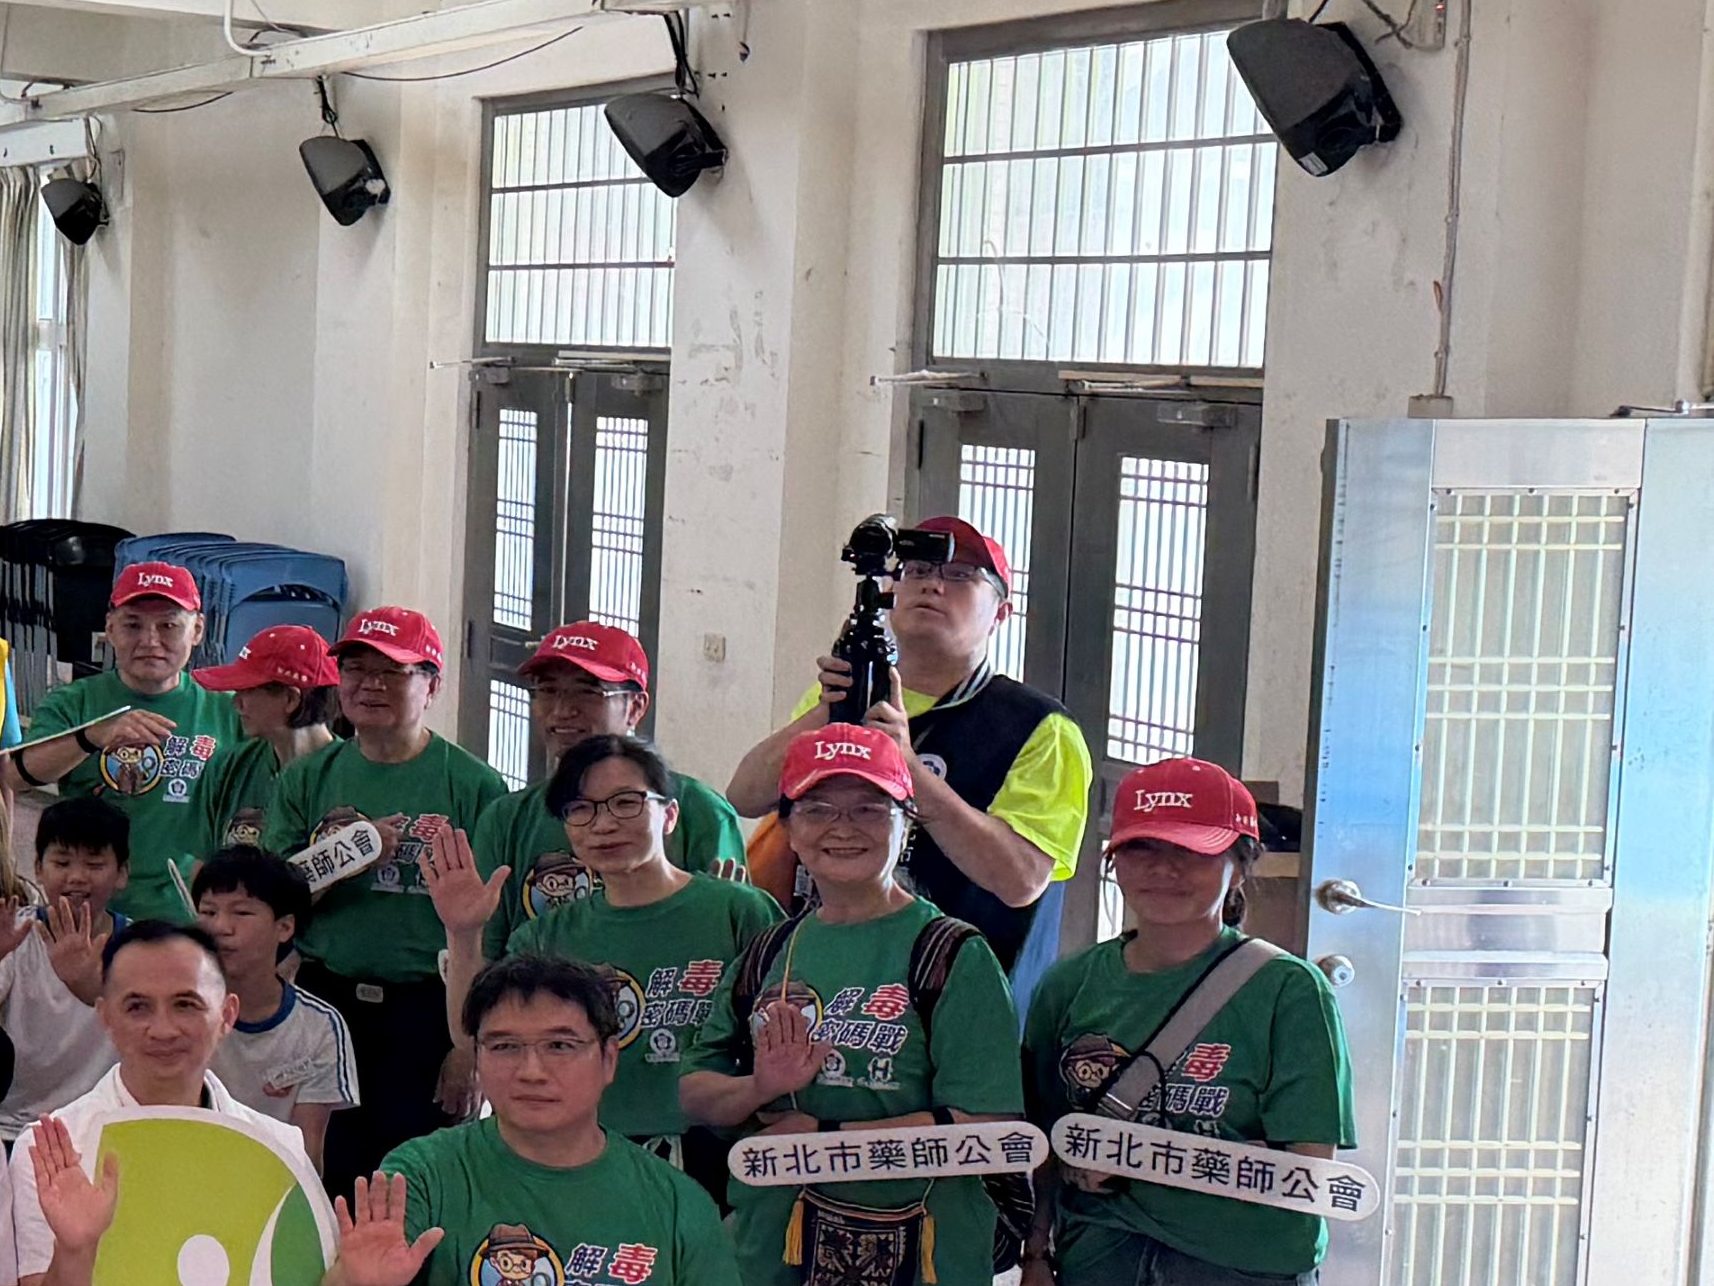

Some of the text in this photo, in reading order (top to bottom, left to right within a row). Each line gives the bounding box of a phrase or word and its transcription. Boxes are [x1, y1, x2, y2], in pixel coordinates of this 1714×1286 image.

[138, 572, 173, 589] Lynx
[357, 618, 398, 637] Lynx
[553, 635, 599, 650] Lynx
[814, 741, 872, 761] Lynx
[1133, 789, 1193, 813] Lynx
[646, 959, 723, 998] 解毒
[825, 983, 911, 1019] 解毒
[811, 1018, 908, 1055] 密碼戰
[742, 1131, 1035, 1179] 新北市藥師公會
[1064, 1122, 1366, 1214] 新北市藥師公會
[564, 1243, 658, 1285] 解毒
